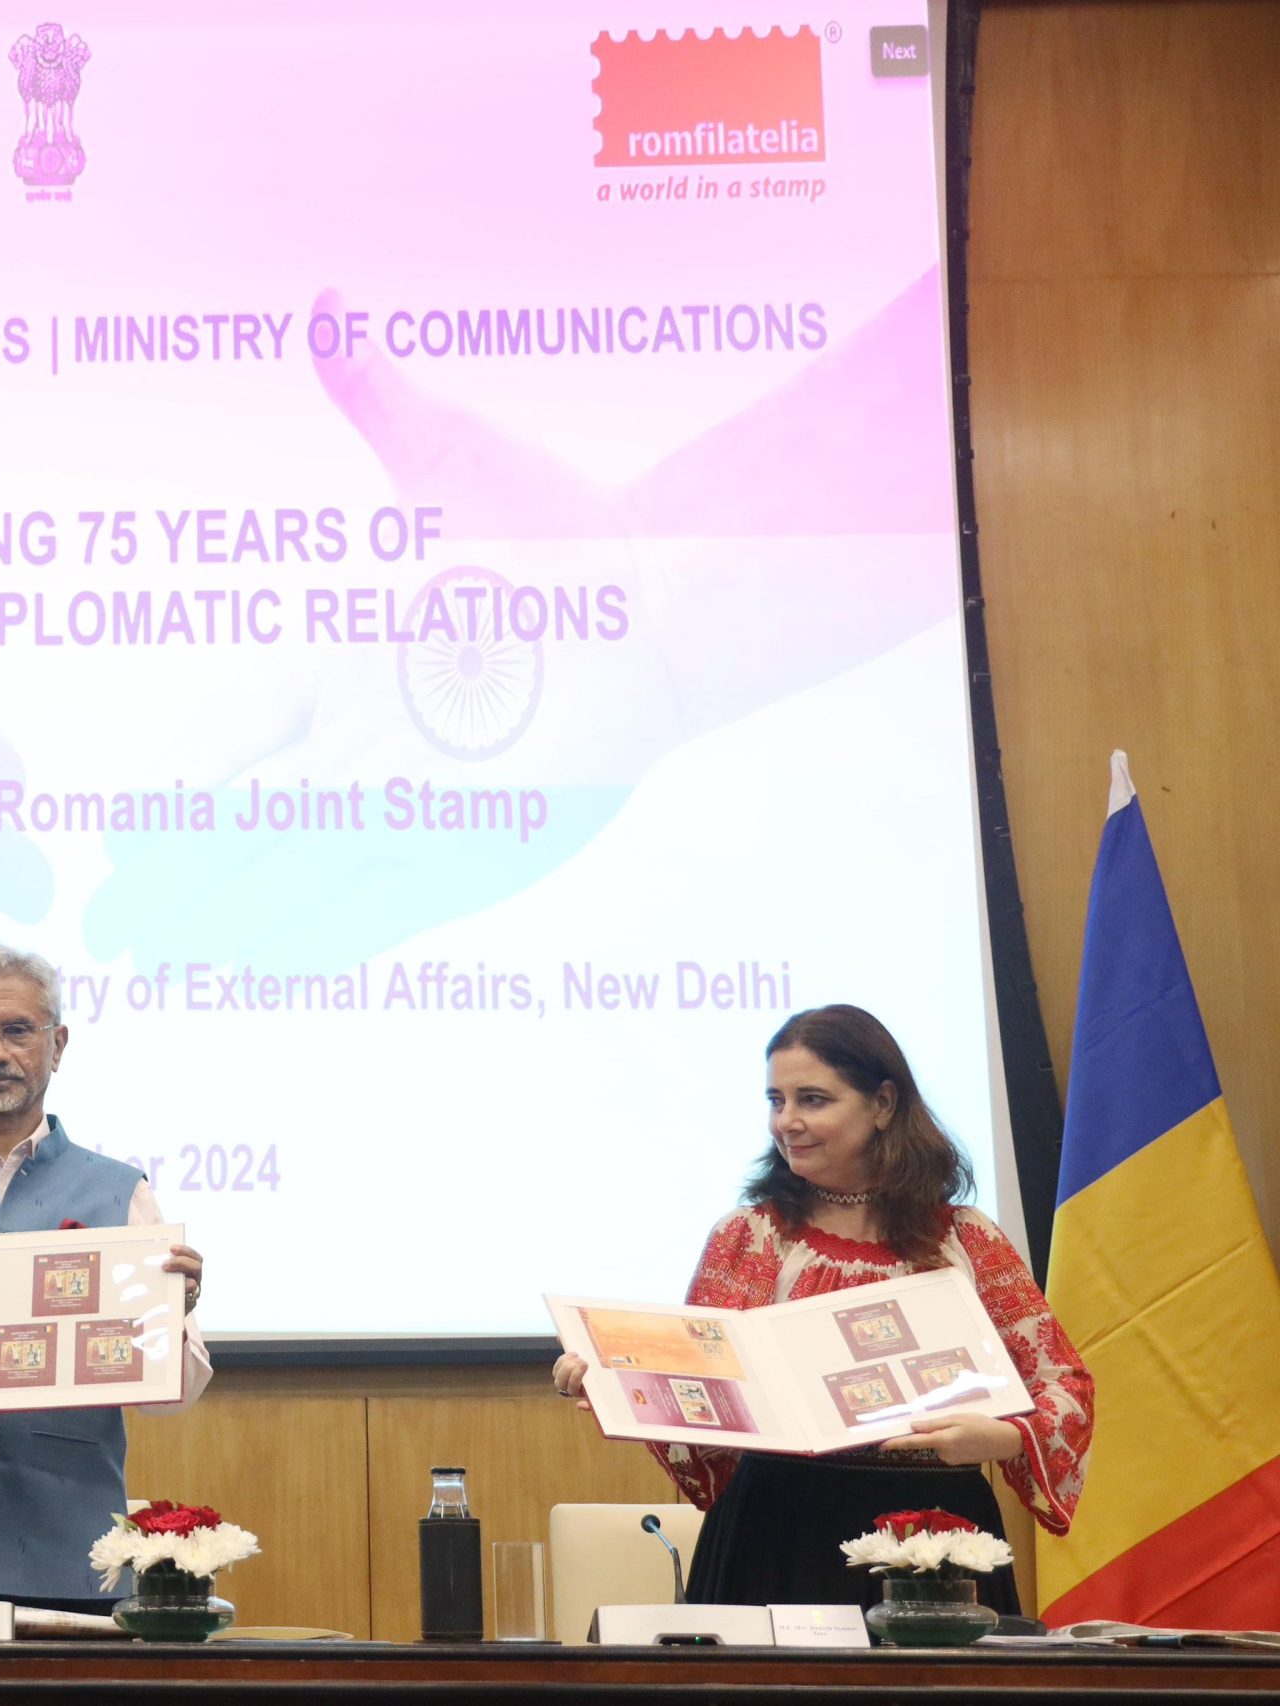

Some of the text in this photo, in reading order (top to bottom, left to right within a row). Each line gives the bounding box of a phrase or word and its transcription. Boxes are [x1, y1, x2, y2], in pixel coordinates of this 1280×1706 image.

[883, 42, 916, 59] Next
[629, 120, 818, 156] romfilatelia
[597, 175, 826, 203] a world in a stamp
[75, 313, 293, 362] MINISTRY
[308, 311, 369, 359] OF
[386, 303, 827, 358] COMMUNICATIONS
[78, 511, 137, 565] 75
[156, 507, 347, 563] YEARS
[369, 507, 442, 562] OF
[306, 584, 629, 644] RELATIONS
[235, 778, 365, 831] Joint
[384, 777, 548, 843] Stamp
[127, 962, 171, 1011] of
[186, 963, 368, 1010] External
[384, 962, 545, 1018] Affairs,
[563, 962, 659, 1010] New
[676, 961, 790, 1010] Delhi
[180, 1144, 281, 1192] 2024
